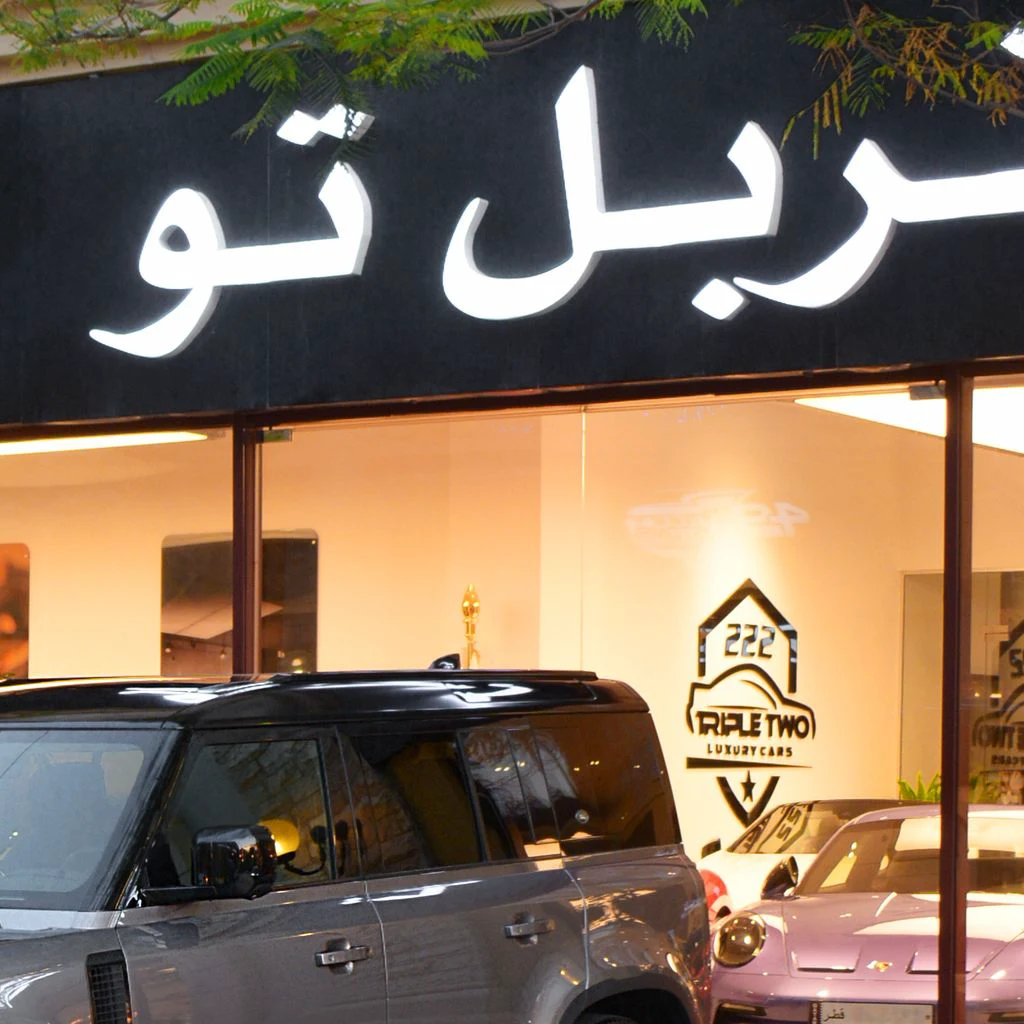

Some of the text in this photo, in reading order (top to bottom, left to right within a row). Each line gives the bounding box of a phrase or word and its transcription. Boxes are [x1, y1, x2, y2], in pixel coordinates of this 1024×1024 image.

[88, 102, 374, 358] تو
[724, 622, 776, 659] 222
[765, 713, 810, 739] TWO
[707, 743, 793, 757] LUXURY CARS
